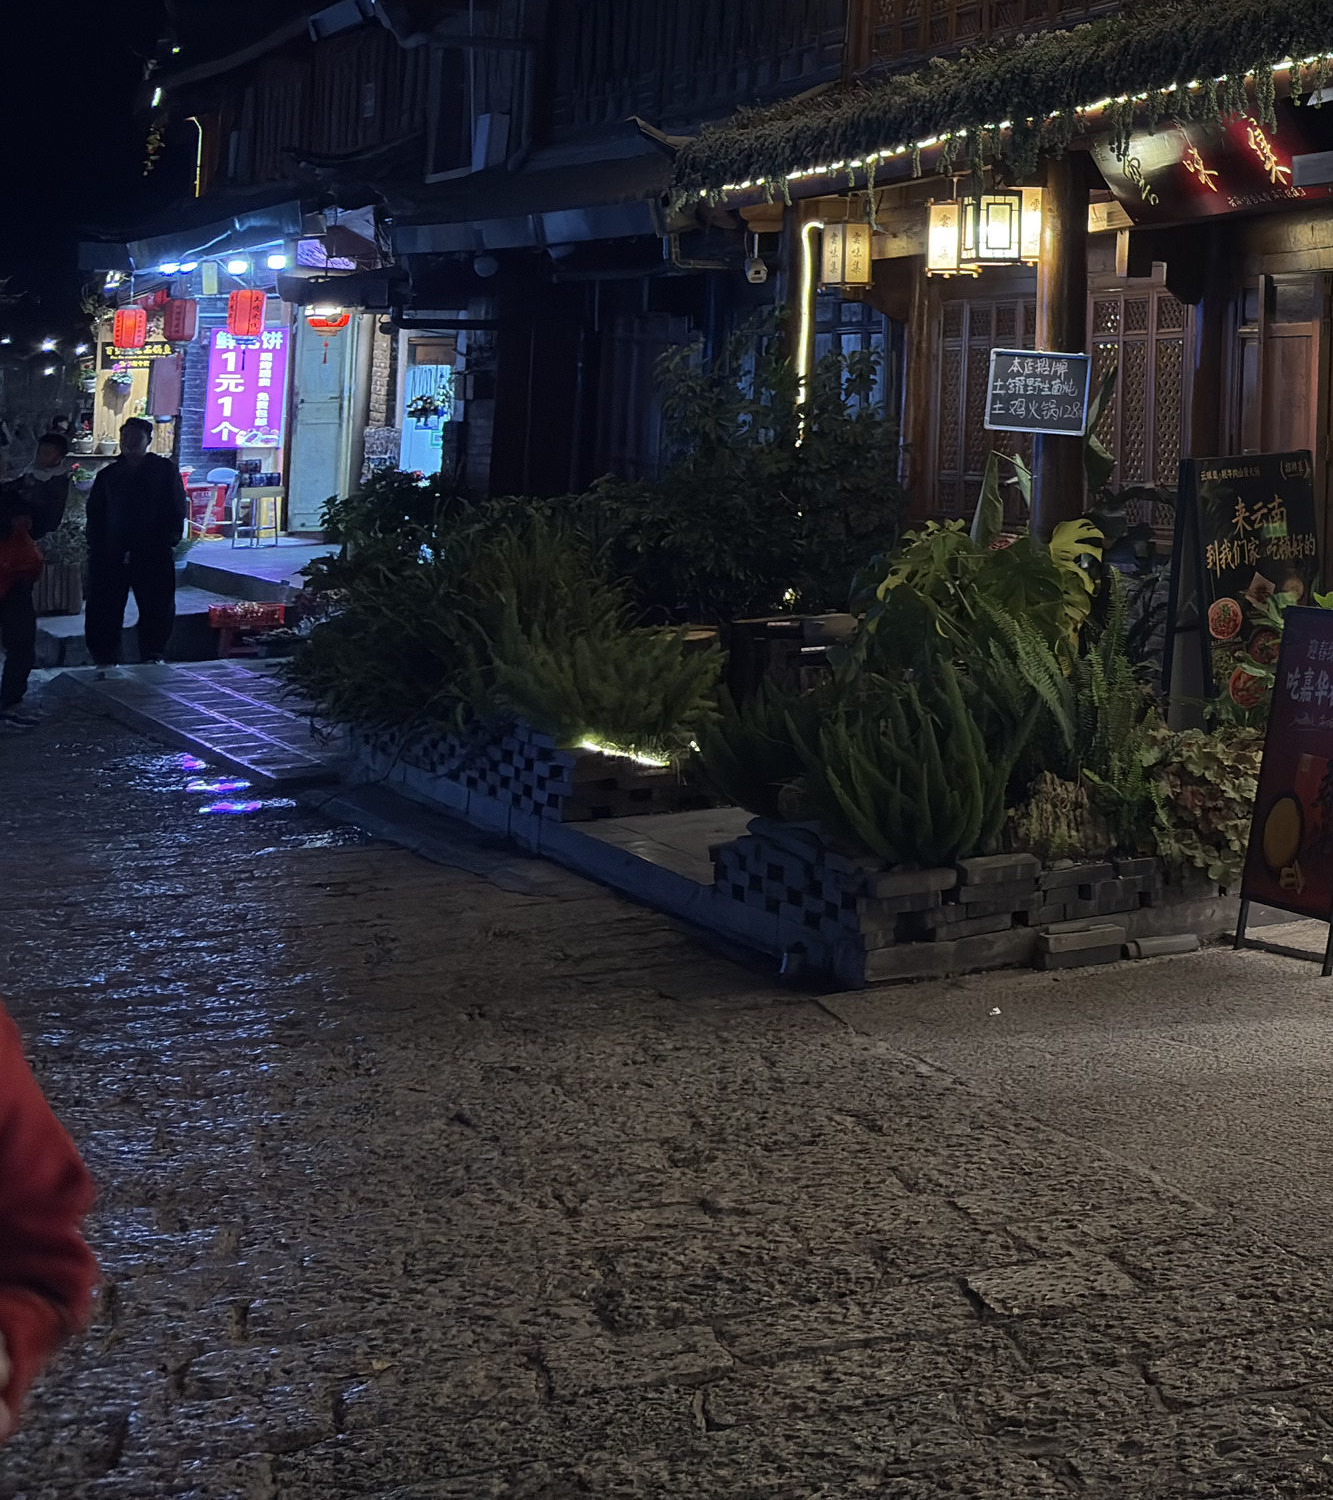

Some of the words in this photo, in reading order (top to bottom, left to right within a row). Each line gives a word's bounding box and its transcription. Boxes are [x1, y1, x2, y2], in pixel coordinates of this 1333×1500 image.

[939, 213, 951, 260] 雲集
[1007, 356, 1068, 381] 本店招牌
[1232, 493, 1288, 539] 来云南
[1206, 536, 1262, 580] 到我们家
